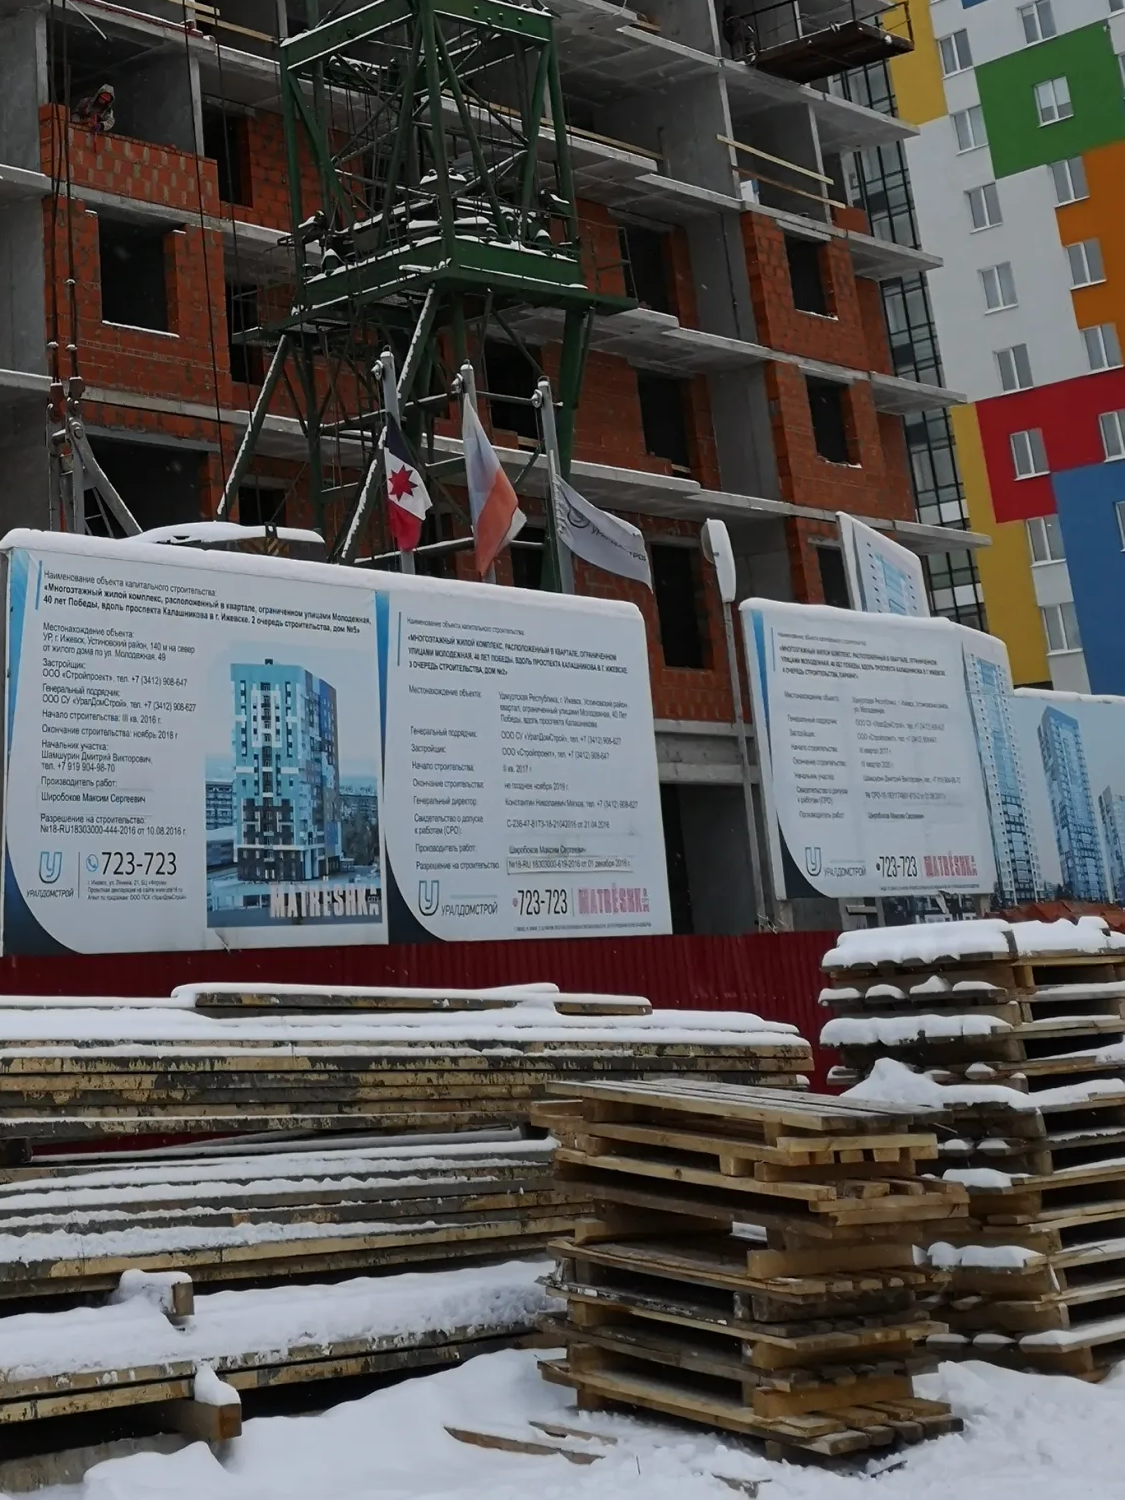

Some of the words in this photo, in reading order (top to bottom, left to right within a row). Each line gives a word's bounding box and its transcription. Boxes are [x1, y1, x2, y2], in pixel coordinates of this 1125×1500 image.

[44, 571, 95, 583] Наименование
[96, 577, 124, 587] объекта
[124, 581, 169, 591] капитального
[44, 583, 102, 596] «Многоэтажный
[103, 590, 127, 598] жилой
[128, 593, 163, 603] комплекс,
[164, 597, 219, 608] расположенный
[226, 604, 257, 614] квартале,
[258, 607, 303, 617] ограниченном
[304, 612, 331, 620] улицами
[43, 595, 52, 604] 40
[68, 598, 100, 610] Победы,
[101, 603, 124, 611] вдоль
[125, 605, 161, 615] проспекта
[162, 607, 208, 619] Калашникова
[251, 616, 255, 624] 2
[256, 618, 283, 627] очередь
[284, 621, 332, 633] строительства,
[43, 623, 105, 635] Местонахождение
[106, 628, 134, 638] объекта:
[52, 646, 75, 654] жилого
[157, 653, 166, 661] 49
[87, 637, 127, 648] Устиновский
[150, 642, 161, 650] 140
[177, 646, 195, 655] север
[456, 638, 475, 647] ЖИЛОЙ
[580, 650, 617, 661] ОГРАНИЧЕННОМ
[408, 647, 434, 657] УЛИЦАМИ
[474, 653, 480, 661] 40
[515, 657, 532, 665] ВДОЛЬ
[532, 658, 561, 668] ПРОСПЕКТА
[413, 661, 438, 671] ОЧЕРЕДЬ
[484, 667, 496, 675] ДОМ
[42, 669, 60, 678] ООО
[131, 674, 140, 683] +7
[141, 674, 162, 686] (3412)
[162, 676, 187, 686] 908-647
[43, 683, 85, 694] Генеральный
[43, 694, 59, 704] ООО
[60, 695, 71, 704] СУ
[143, 700, 151, 709] +7
[153, 700, 173, 712] (3412)
[173, 702, 196, 711] 908-627
[42, 710, 69, 719] Начало
[69, 713, 121, 722] строительства:
[140, 715, 156, 723] 2016
[41, 725, 79, 735] Окончание
[81, 728, 132, 737] строительства:
[133, 729, 157, 740] ноябрь
[157, 730, 174, 739] 2018
[501, 731, 514, 740] ООО
[516, 732, 523, 740] СУ
[41, 740, 79, 749] Начальник
[80, 743, 108, 751] участка:
[502, 748, 516, 756] ООО
[41, 751, 80, 762] Шамшурин
[81, 752, 111, 763] Дмитрий
[57, 763, 66, 771] +7
[67, 763, 80, 771] 919
[82, 763, 115, 772] 904-98-70
[41, 776, 94, 787] Производитель
[41, 793, 81, 803] Широбоков
[82, 793, 109, 802] Максим
[110, 794, 146, 804] Сергеевич
[40, 814, 84, 824] Разрешение
[147, 826, 181, 835] 10.08.2016
[102, 852, 176, 875] 723-723
[880, 856, 917, 878] 723-723
[27, 888, 74, 899] УРАЛДОМСТРОЙ
[441, 902, 498, 917] УРАЛДОМСТРОЙ
[518, 889, 568, 915] 723-723
